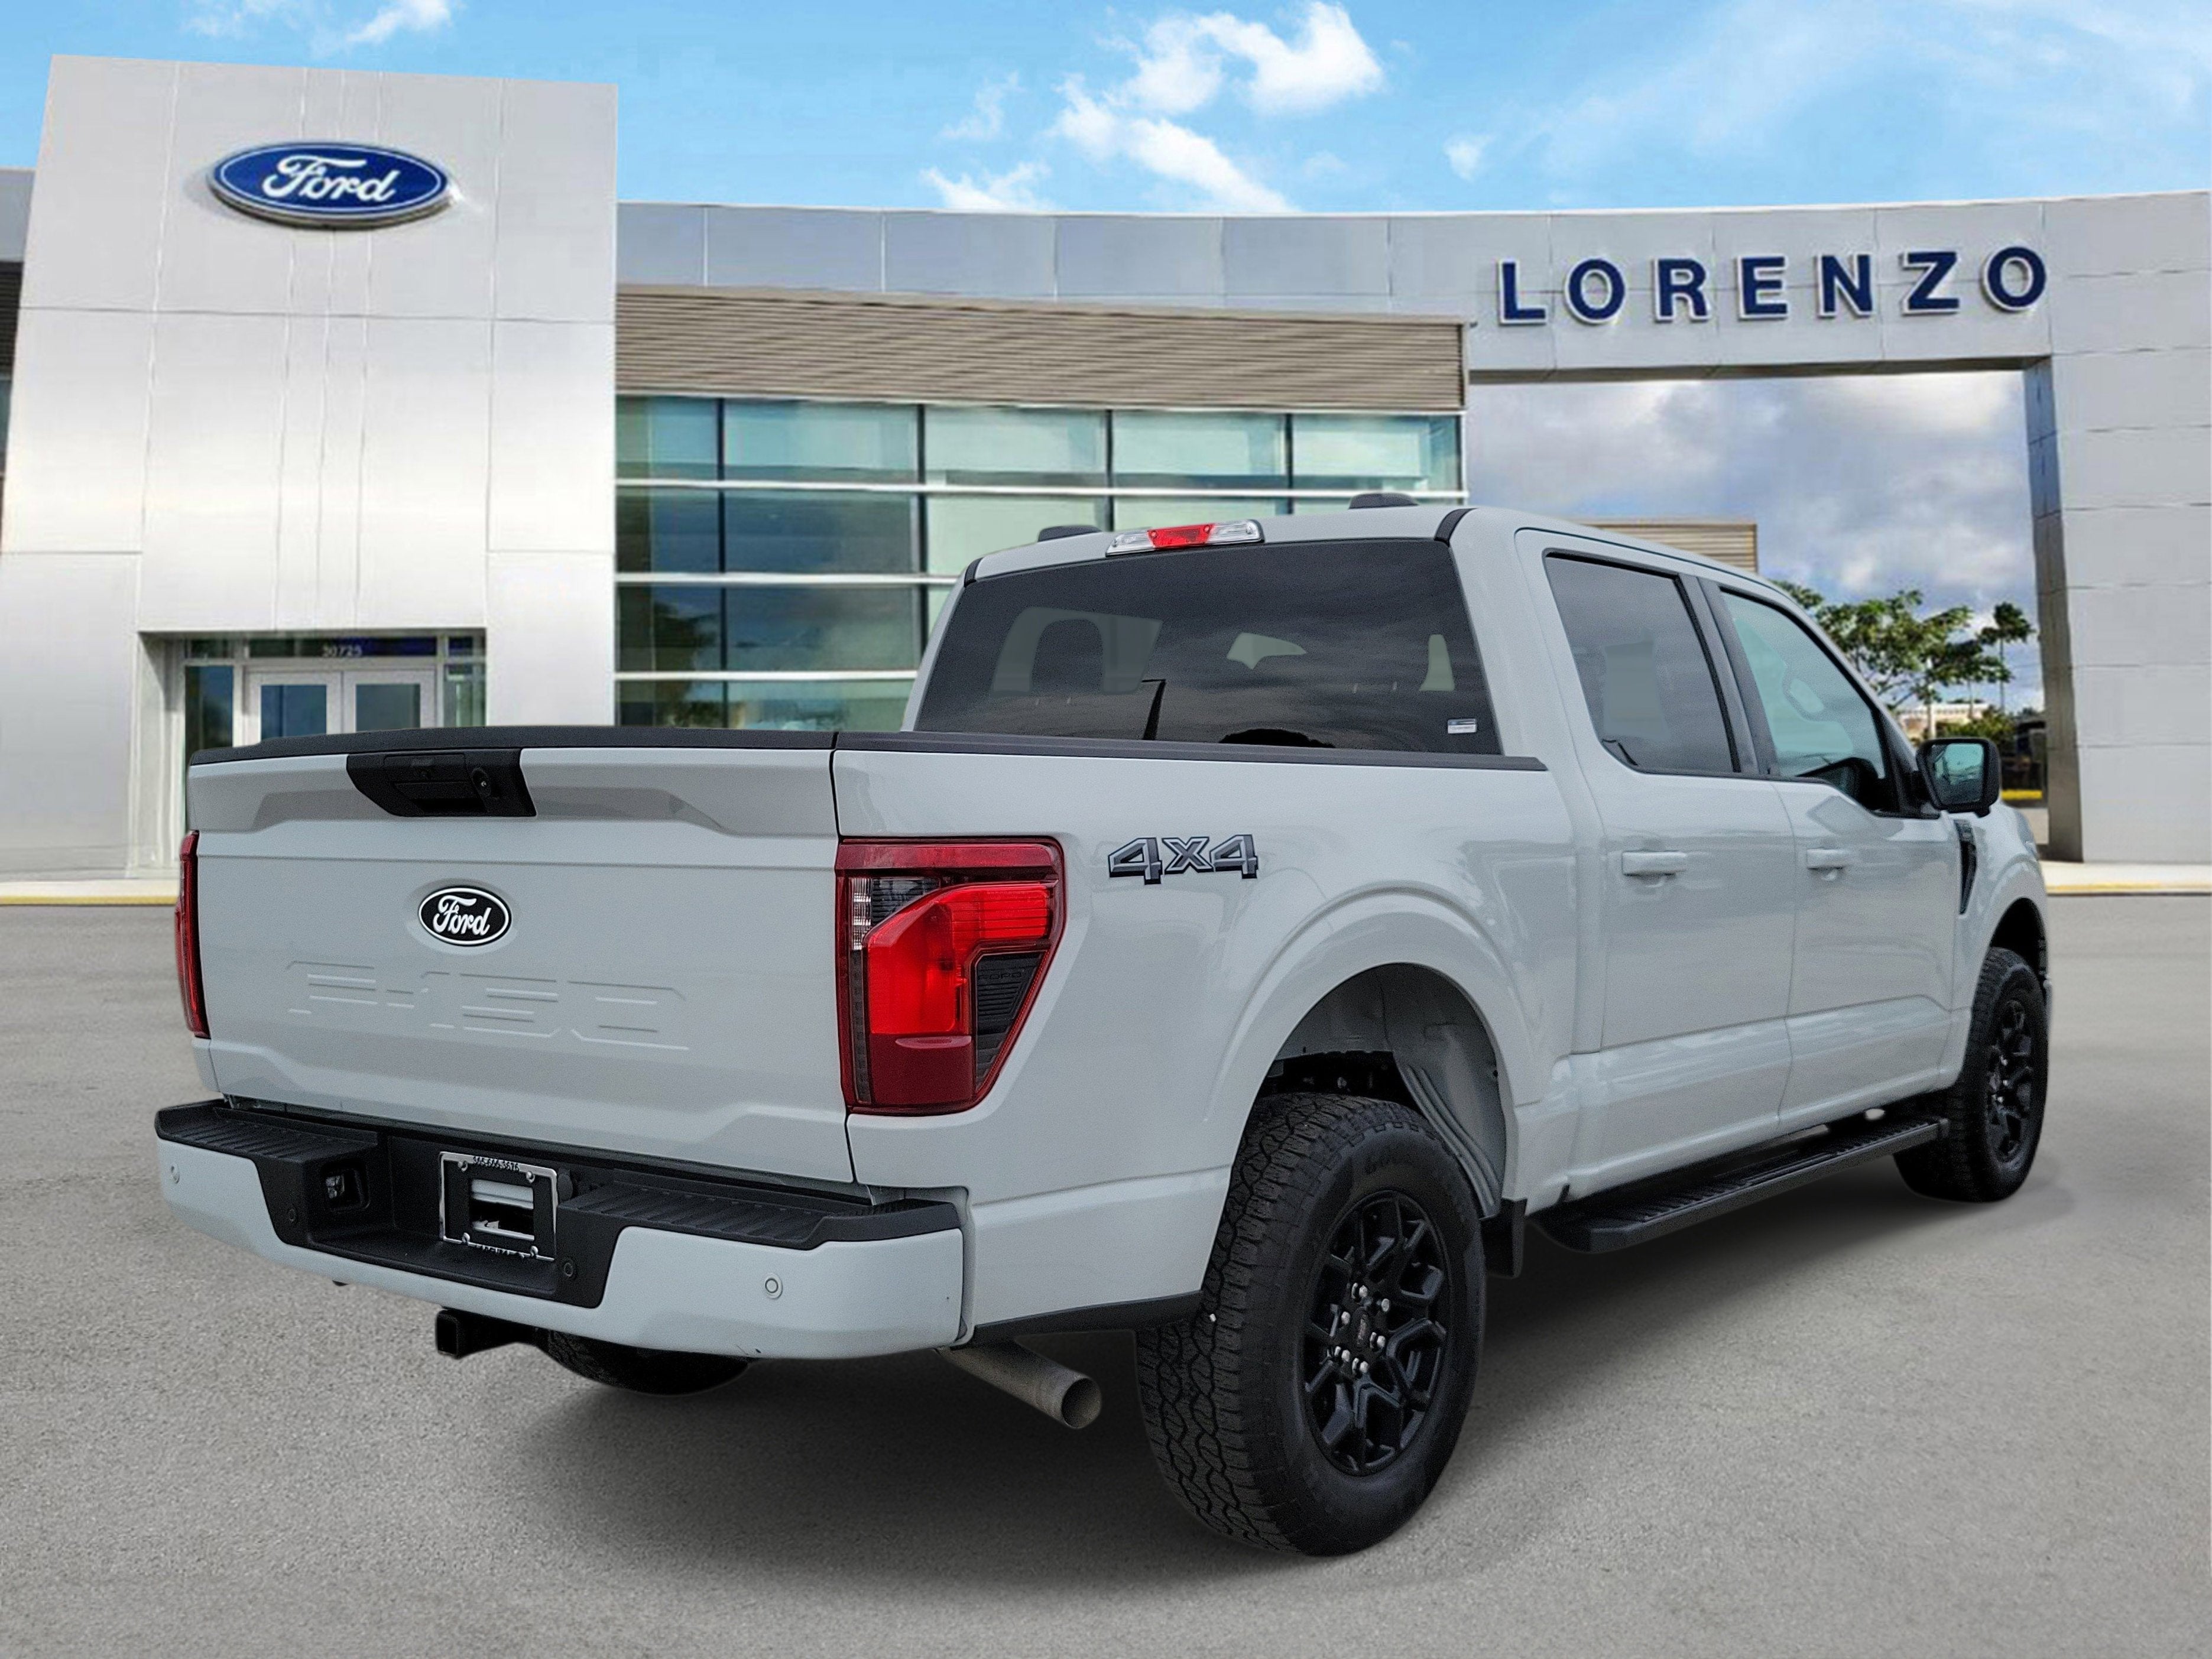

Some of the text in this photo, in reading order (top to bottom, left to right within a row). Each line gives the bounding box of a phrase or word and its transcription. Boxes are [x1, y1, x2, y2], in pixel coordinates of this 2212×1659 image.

[262, 154, 400, 202] Ford
[1499, 246, 2046, 324] LORENZO
[1108, 834, 1258, 885] 4X4
[433, 894, 491, 936] Ford
